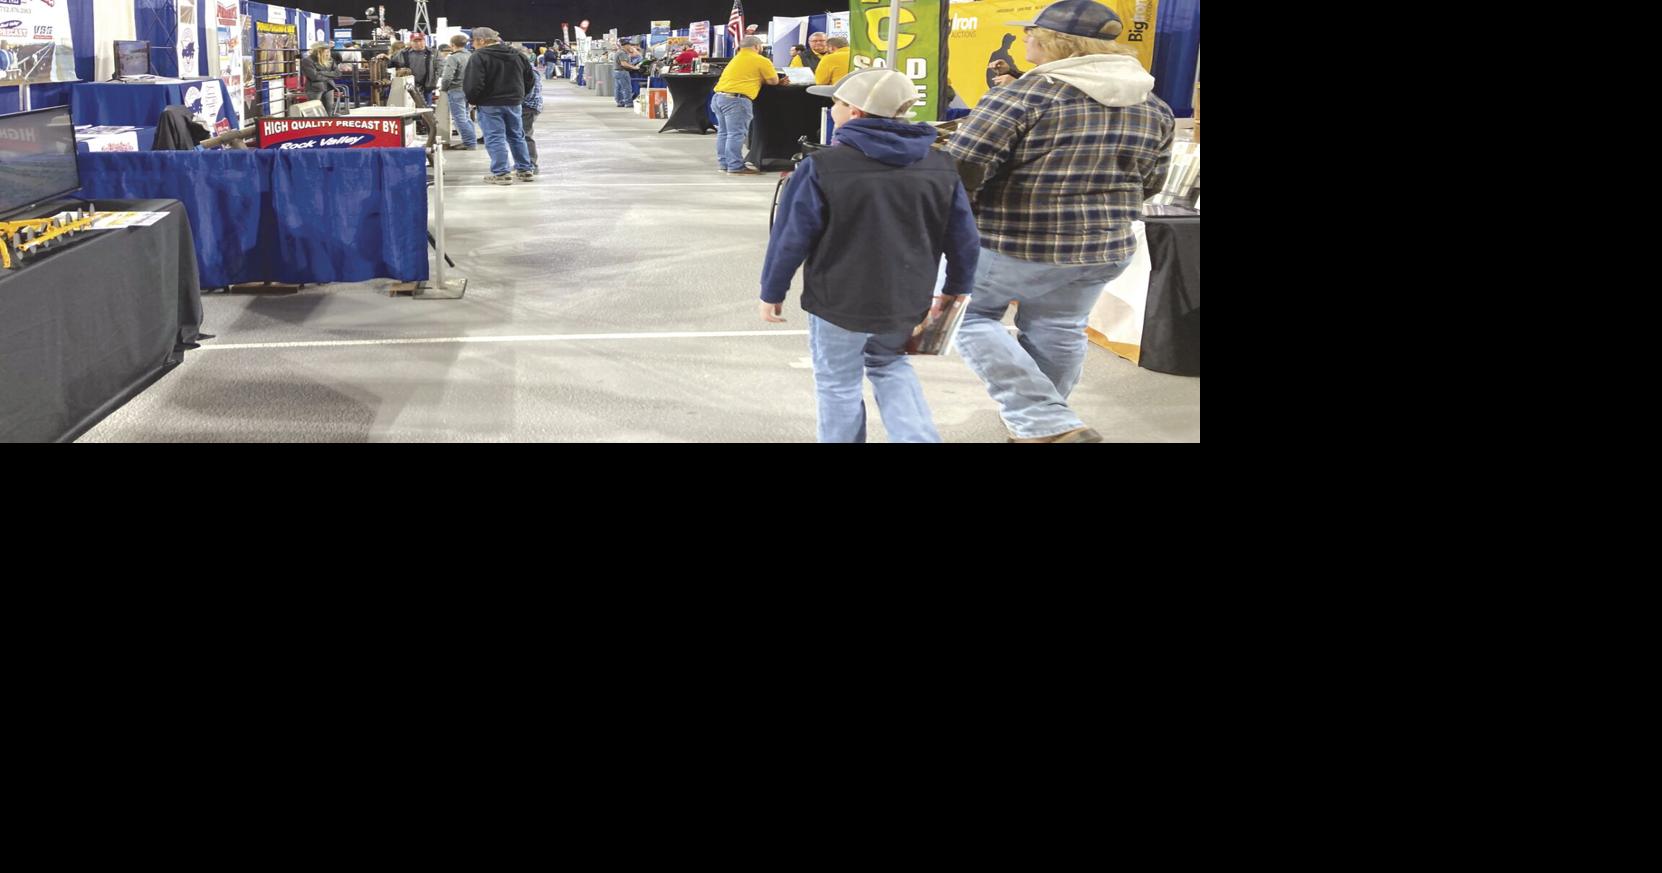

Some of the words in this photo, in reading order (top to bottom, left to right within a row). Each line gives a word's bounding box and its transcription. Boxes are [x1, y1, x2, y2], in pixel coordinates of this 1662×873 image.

[263, 120, 289, 136] HIGH
[291, 120, 333, 130] QUALITY
[336, 120, 380, 131] PRECAST
[382, 120, 398, 135] BY:
[279, 140, 317, 150] Rock
[319, 135, 365, 147] Valley
